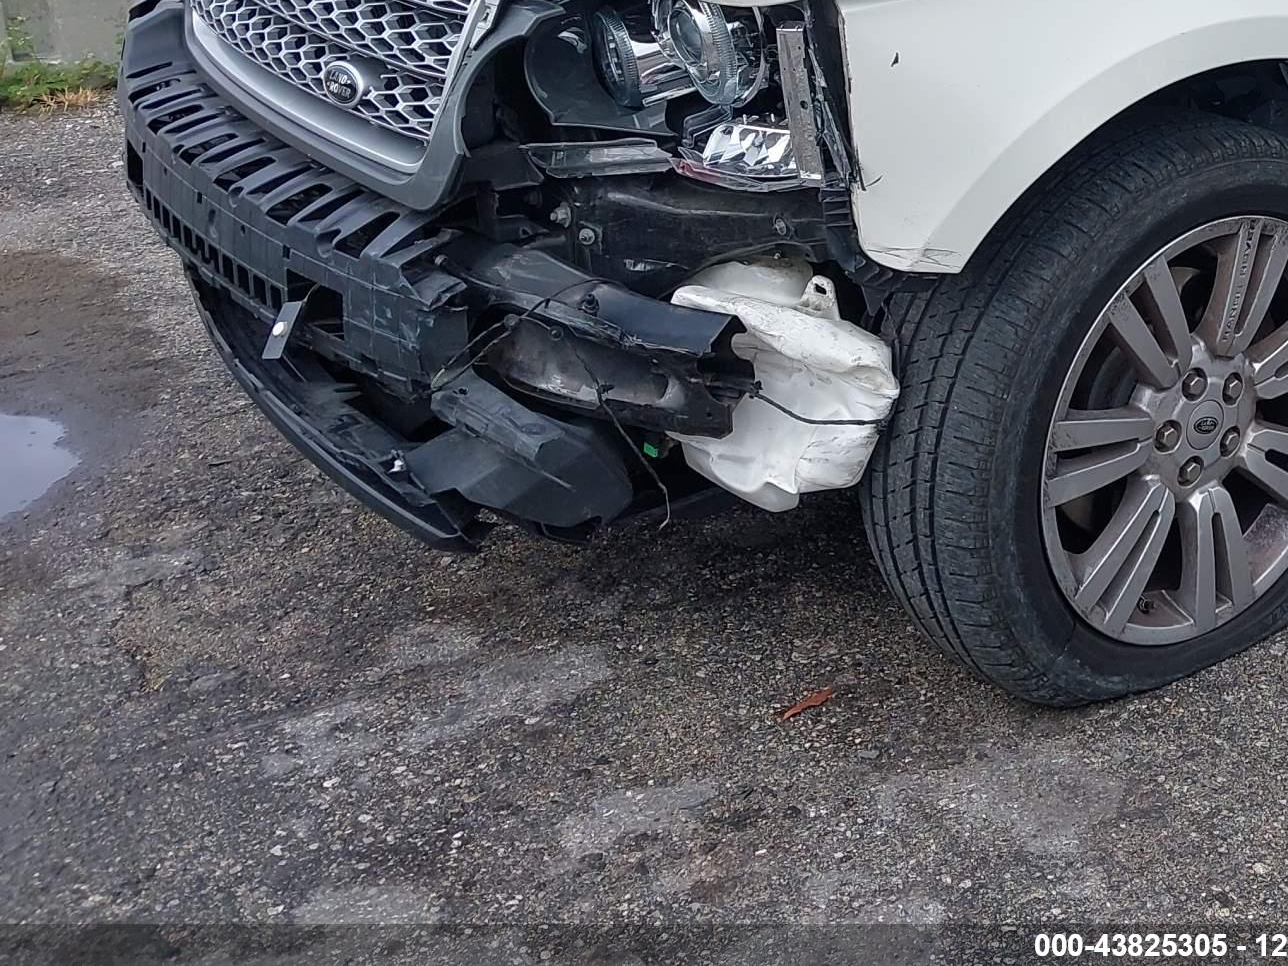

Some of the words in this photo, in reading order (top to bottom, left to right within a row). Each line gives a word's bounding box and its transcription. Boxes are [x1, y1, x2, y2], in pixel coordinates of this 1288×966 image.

[330, 70, 348, 85] LAND
[329, 81, 351, 99] ROVER
[1240, 218, 1256, 277] ROVER
